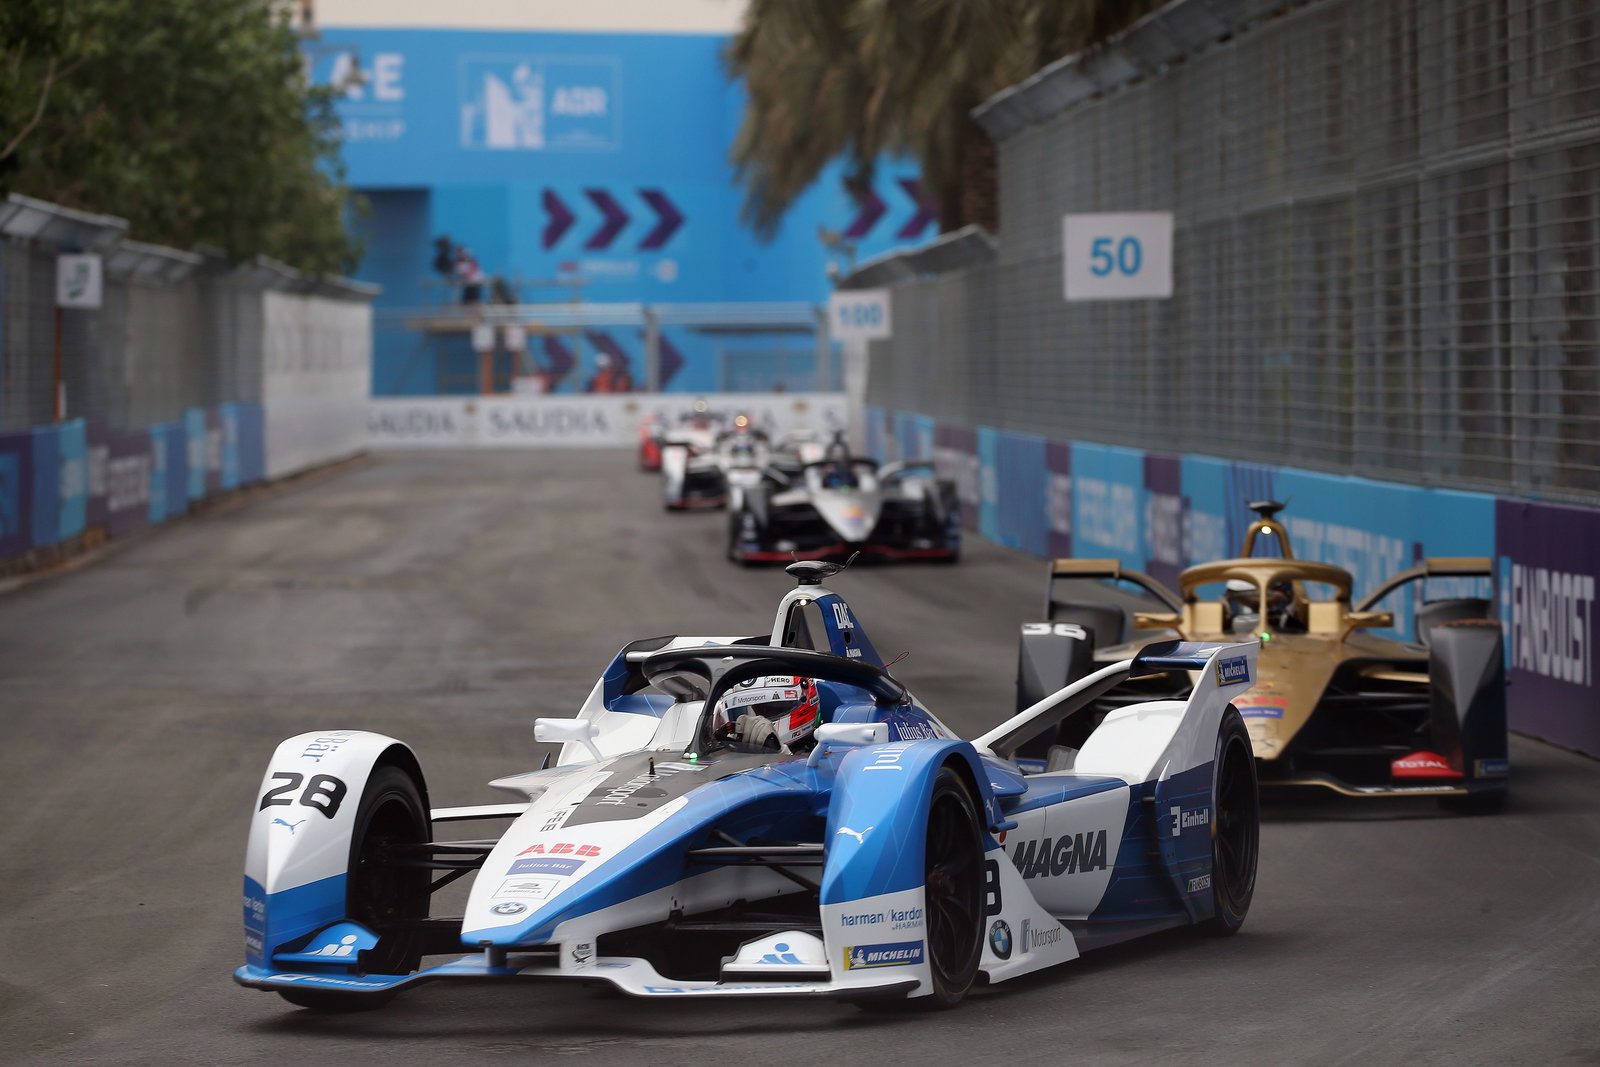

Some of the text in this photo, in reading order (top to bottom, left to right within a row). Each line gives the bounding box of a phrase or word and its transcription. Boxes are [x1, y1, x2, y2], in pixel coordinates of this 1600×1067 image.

[1089, 236, 1143, 277] 50
[838, 303, 883, 328] 100
[488, 404, 609, 437] SAUDIA
[1512, 563, 1595, 688] FANBOOST
[738, 694, 766, 704] Motorsport
[894, 721, 923, 741] Julius
[301, 737, 349, 763] Bär
[1395, 760, 1448, 769] TOTAL
[258, 771, 348, 819] 28
[1182, 808, 1209, 828] Einhell
[515, 843, 602, 857] ABB
[1012, 829, 1107, 880] MAGNA
[1031, 927, 1061, 948] Motorsport
[867, 948, 921, 962] MICHELIN
